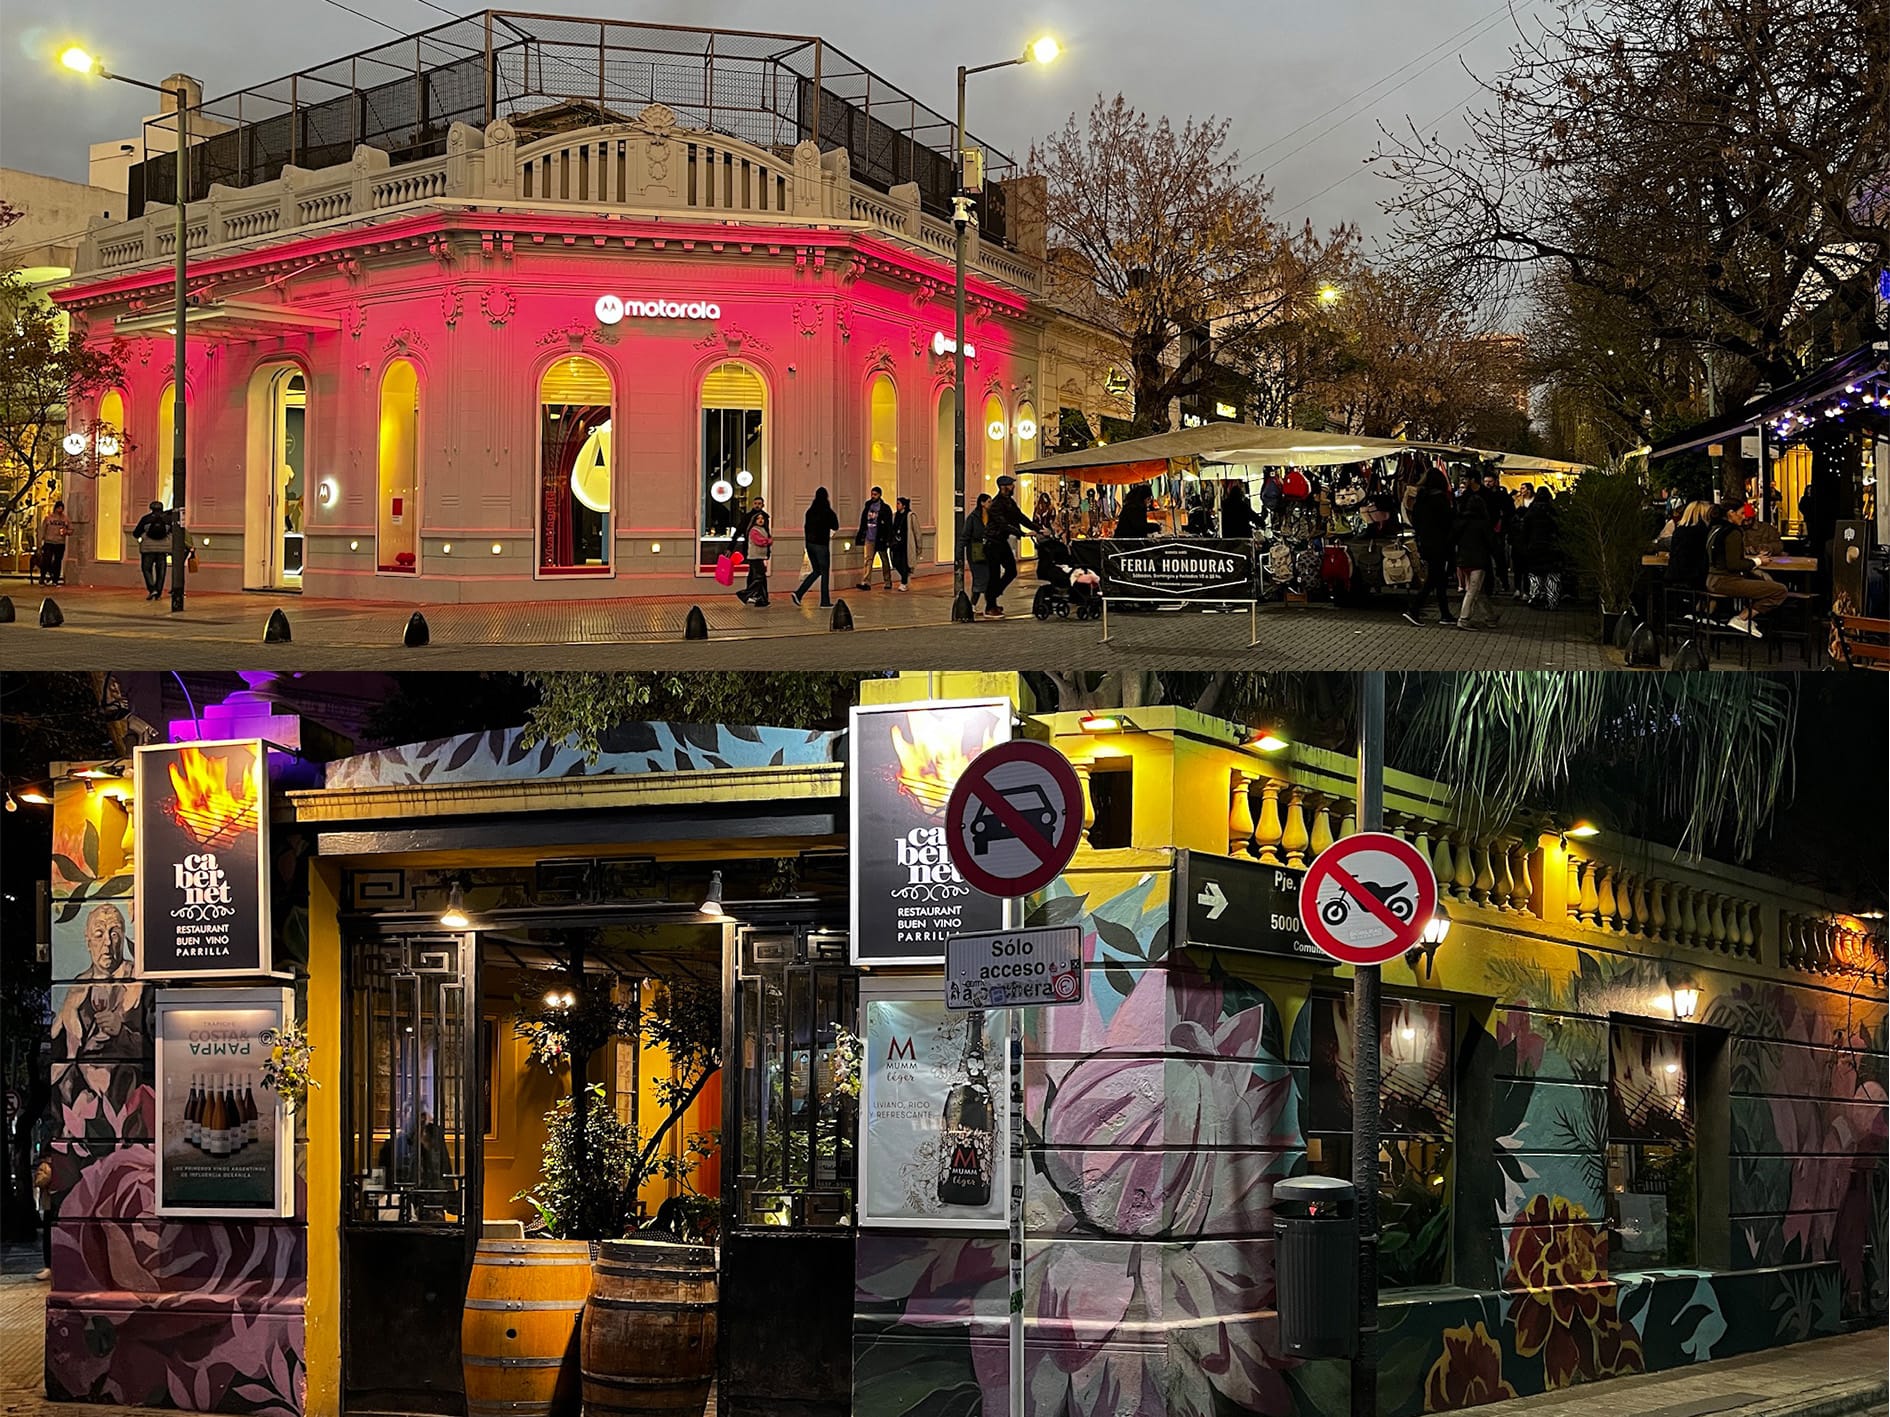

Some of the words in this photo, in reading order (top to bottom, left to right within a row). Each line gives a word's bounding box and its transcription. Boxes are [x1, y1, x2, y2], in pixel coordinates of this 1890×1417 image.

[625, 299, 720, 319] motorola
[944, 338, 976, 358] moola
[1120, 558, 1156, 573] FERIA
[1162, 558, 1235, 573] HONDURAS
[1274, 870, 1297, 892] Pje.
[897, 905, 962, 917] RESTAURANT
[897, 919, 927, 929] BUEN
[933, 918, 962, 928] VINO
[1270, 913, 1300, 932] 5000
[176, 924, 230, 935] RESTAURANT
[176, 936, 200, 946] BUEN
[205, 935, 230, 945] VINO
[897, 931, 960, 942] PARRIL
[176, 947, 230, 957] PARRILLA
[991, 938, 1034, 957] Sólo
[1293, 940, 1325, 955] Comun
[980, 961, 1046, 979] acceso
[189, 1043, 250, 1055] PAMPA
[887, 1035, 917, 1060] M
[886, 1072, 916, 1084] léger
[873, 1101, 906, 1110] LIVIANO,
[908, 1101, 930, 1109] RICO
[876, 1111, 932, 1119] REFRESCANTE
[952, 1168, 978, 1176] MUMM
